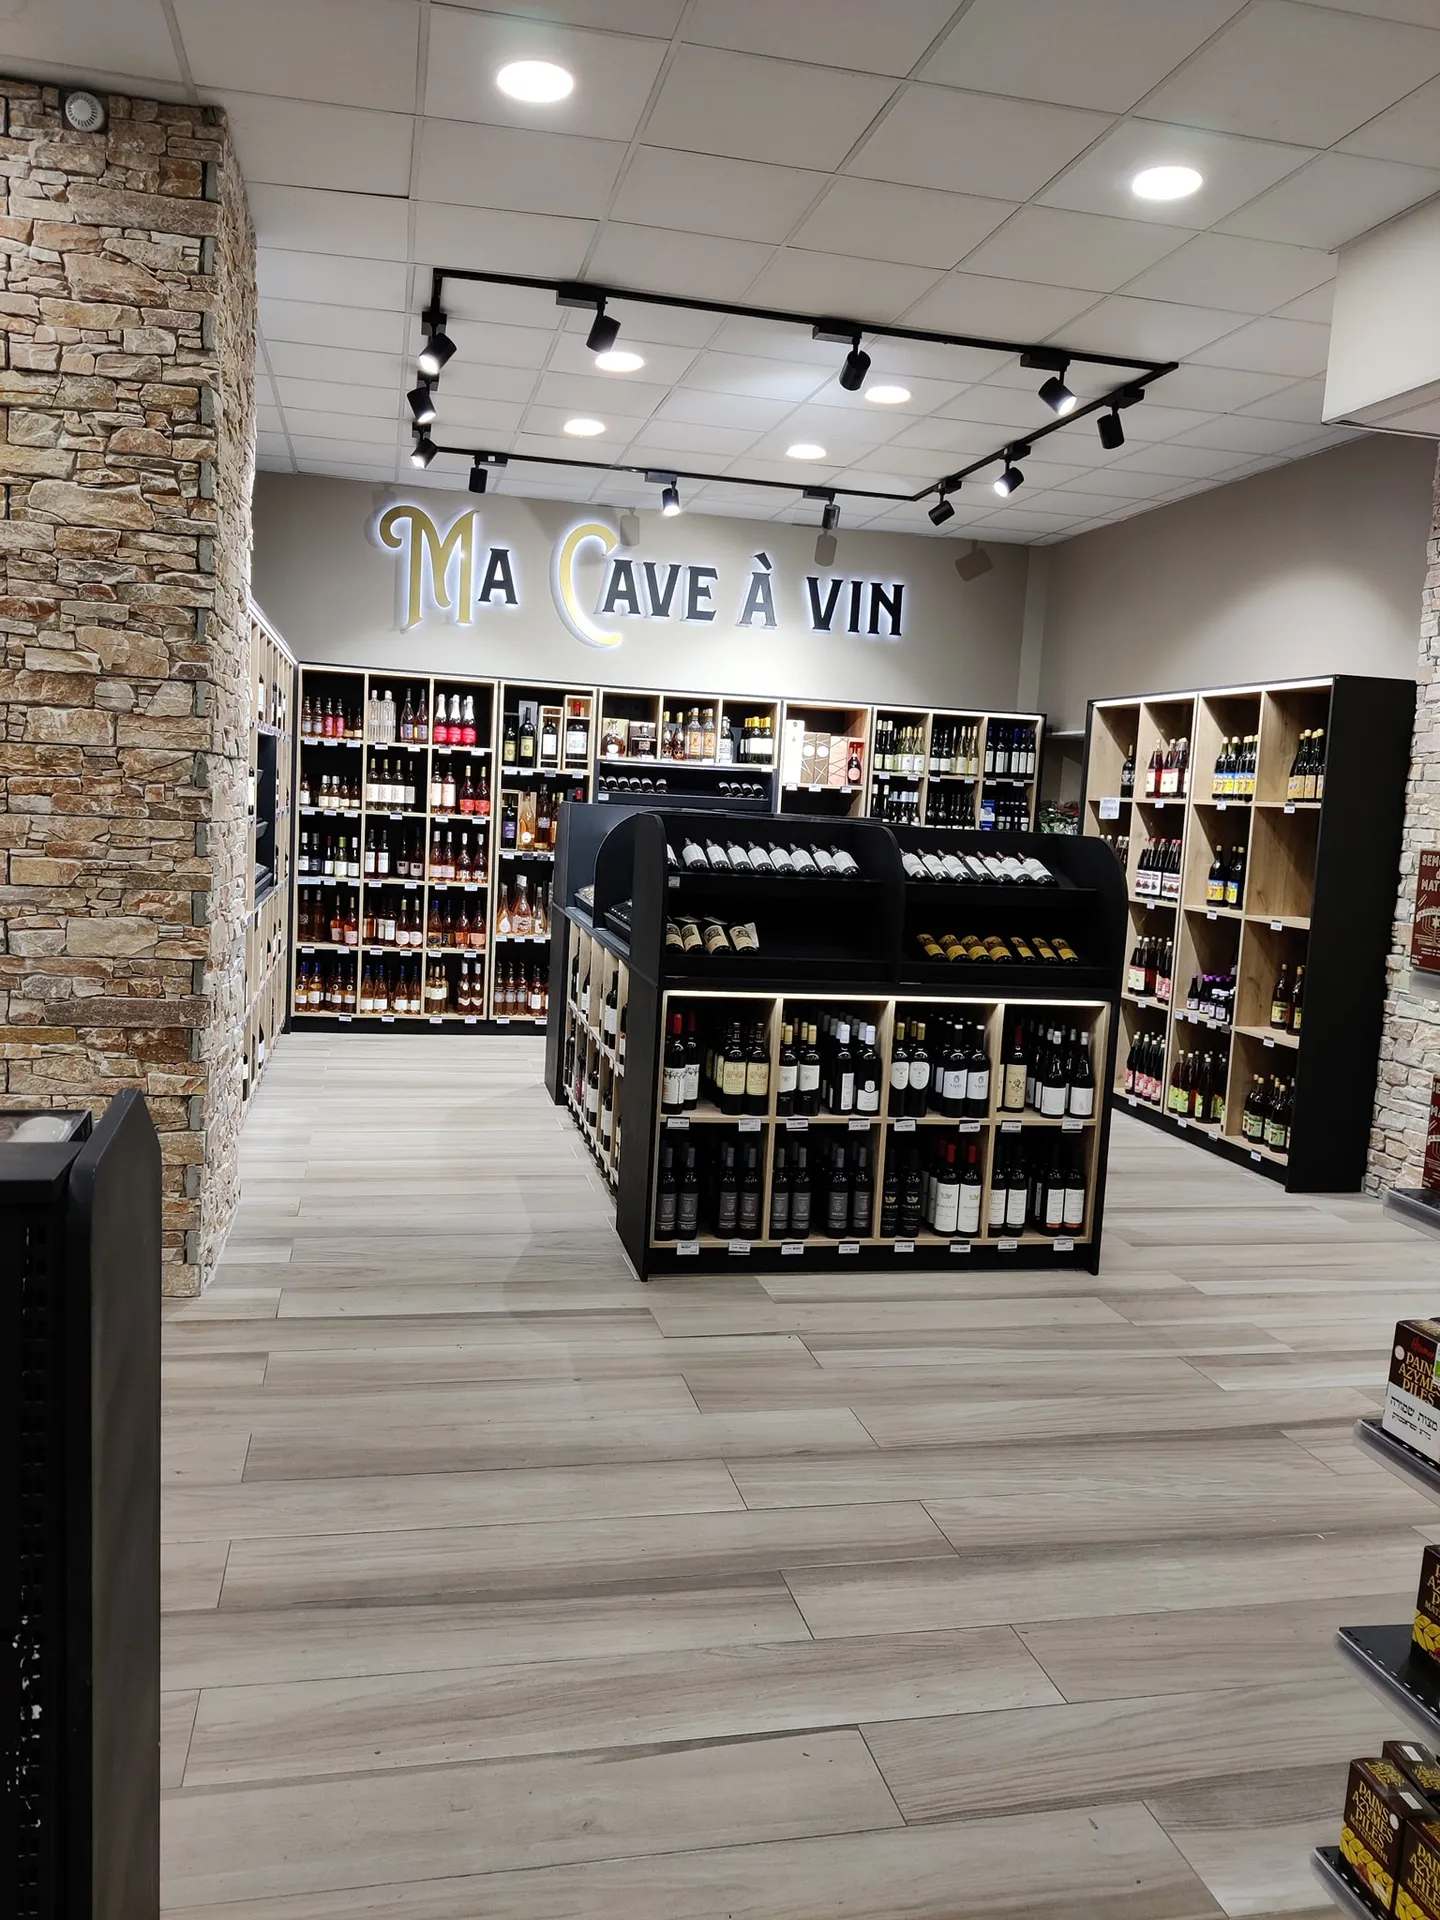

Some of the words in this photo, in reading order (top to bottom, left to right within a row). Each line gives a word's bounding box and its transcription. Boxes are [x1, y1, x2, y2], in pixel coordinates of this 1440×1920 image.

[738, 551, 778, 627] À
[806, 576, 905, 636] VIN
[1406, 1352, 1434, 1378] PAIN
[1352, 1791, 1393, 1843] AZYMES
[1359, 1781, 1389, 1822] PAINS
[1355, 1806, 1385, 1849] PILES
